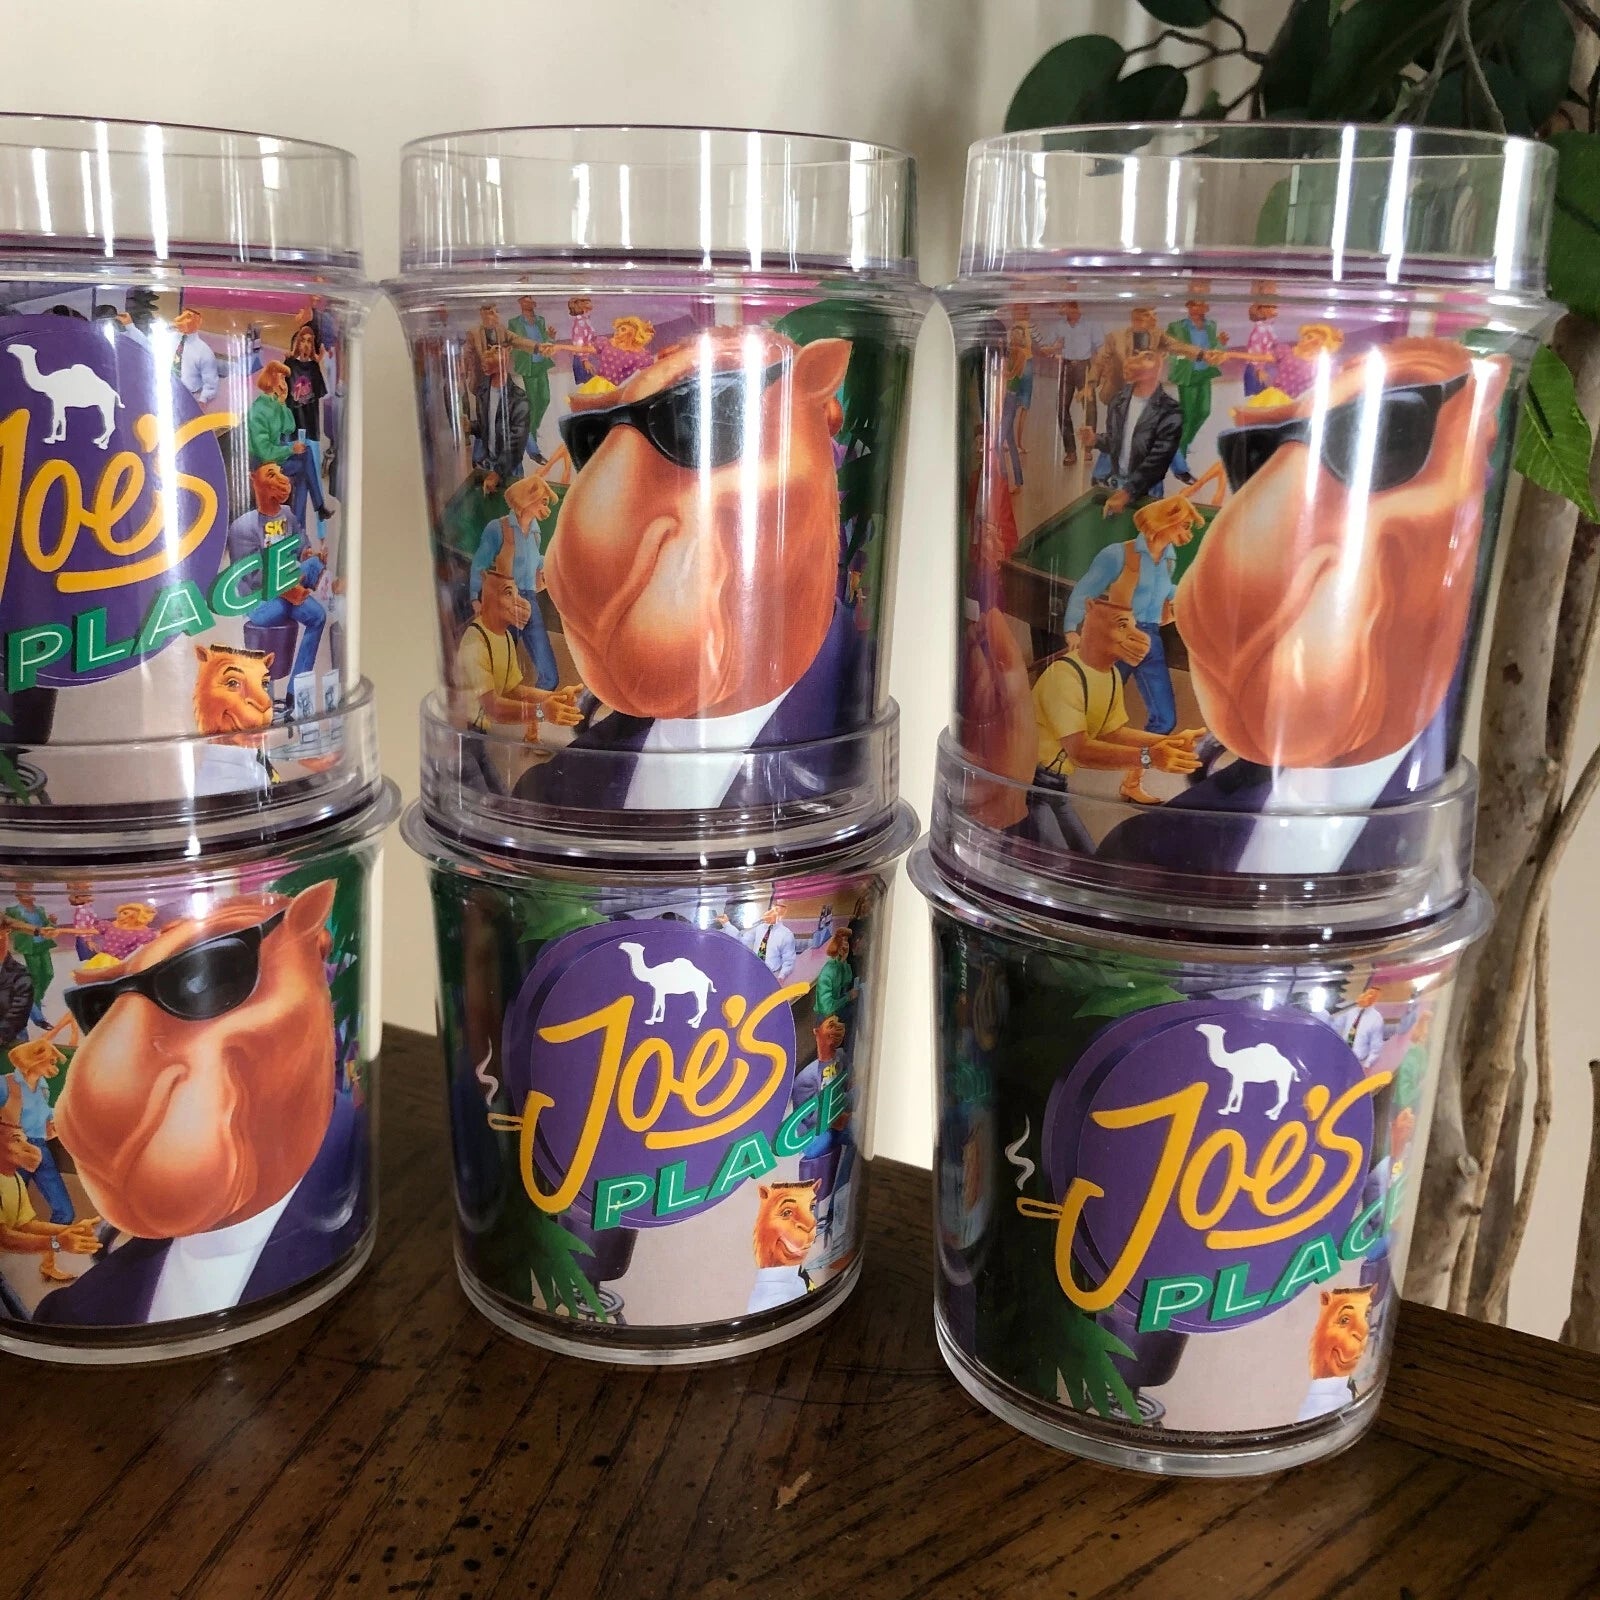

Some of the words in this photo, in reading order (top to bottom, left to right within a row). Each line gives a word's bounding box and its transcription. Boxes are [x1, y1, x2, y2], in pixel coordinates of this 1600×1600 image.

[0, 408, 241, 602] oe's
[4, 533, 302, 694] PLACE
[519, 982, 811, 1214] Joe's
[590, 1072, 849, 1231] PLACE
[1055, 1070, 1393, 1312] Joe's
